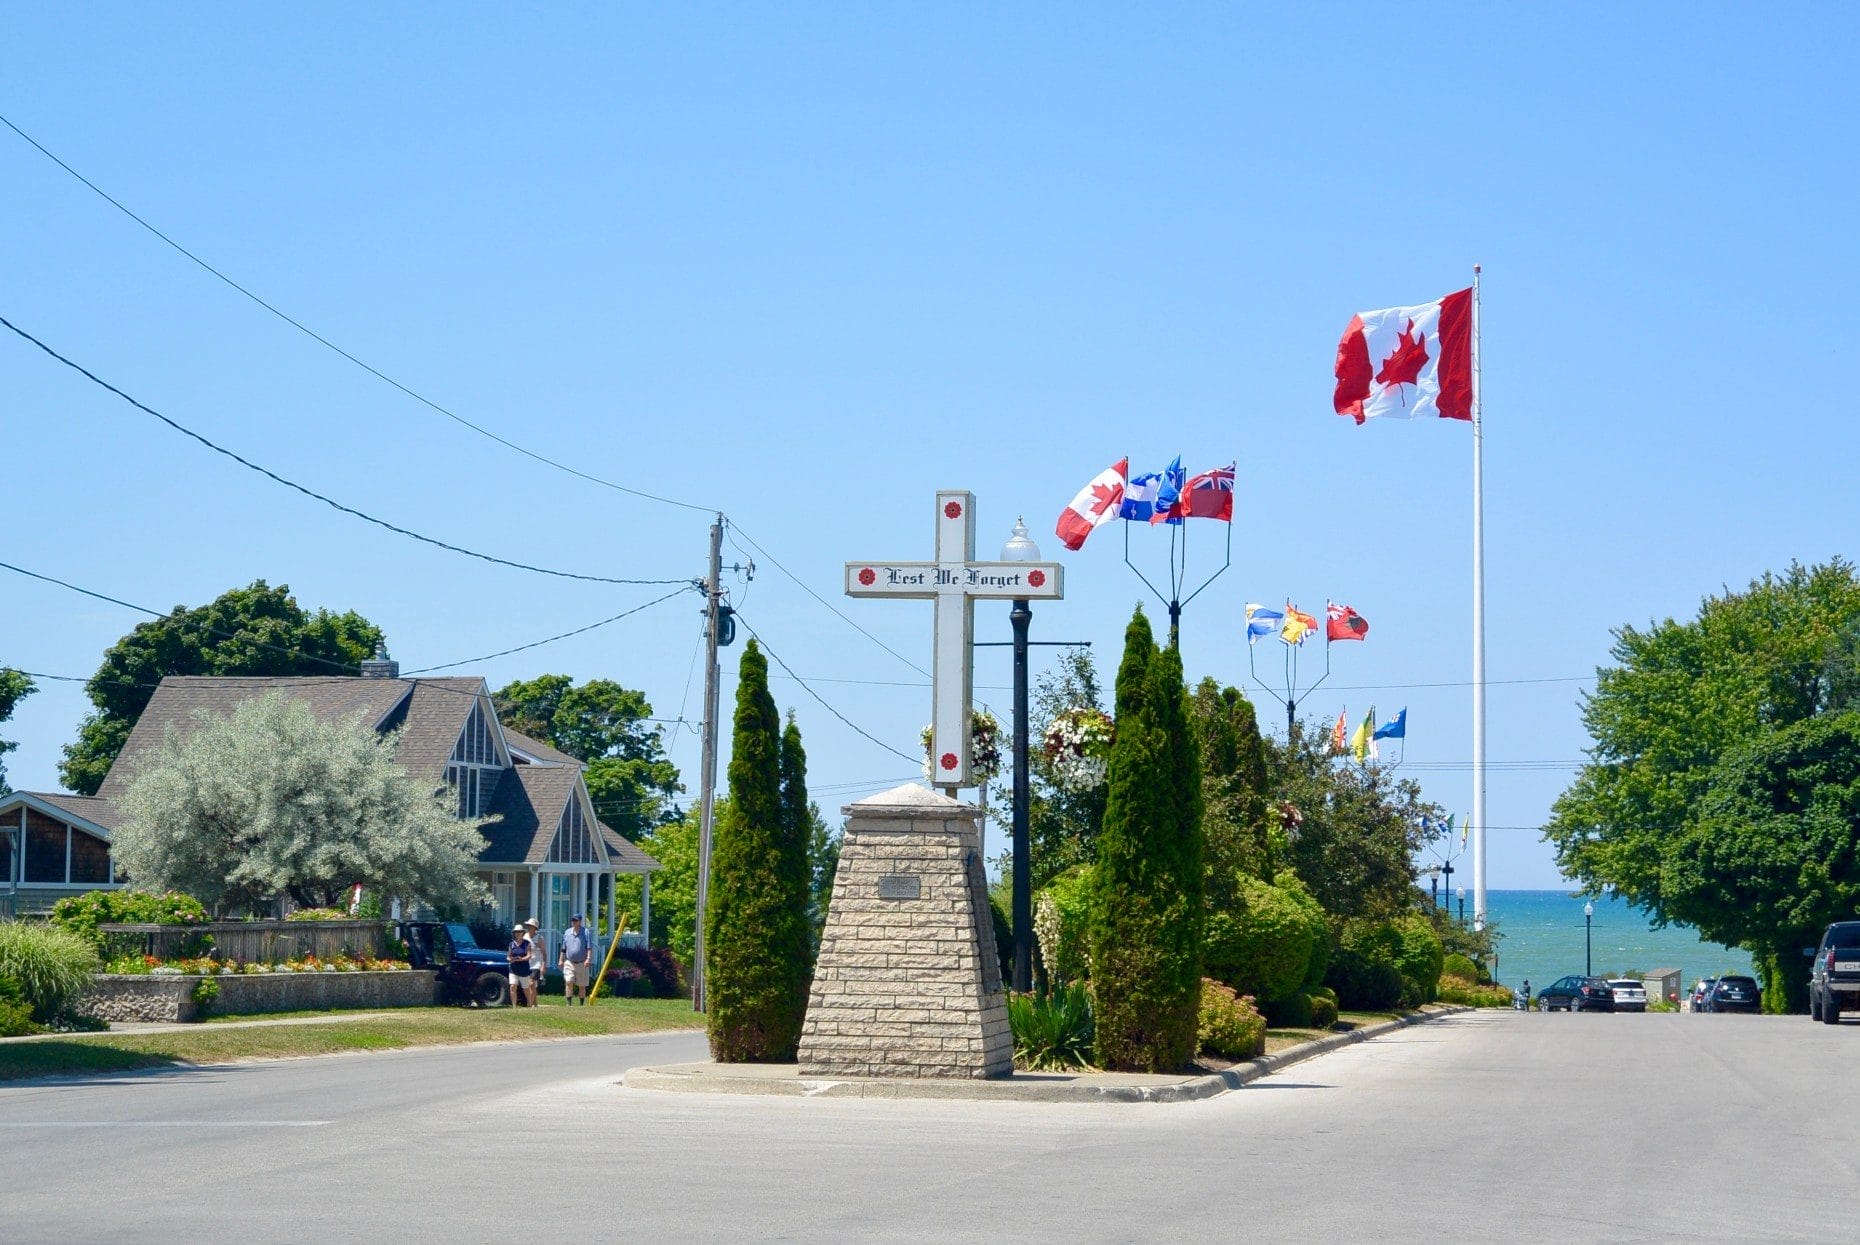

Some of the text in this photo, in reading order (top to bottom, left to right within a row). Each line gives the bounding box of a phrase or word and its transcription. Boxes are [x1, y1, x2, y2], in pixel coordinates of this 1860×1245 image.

[883, 567, 1020, 590] Lest We Forget
